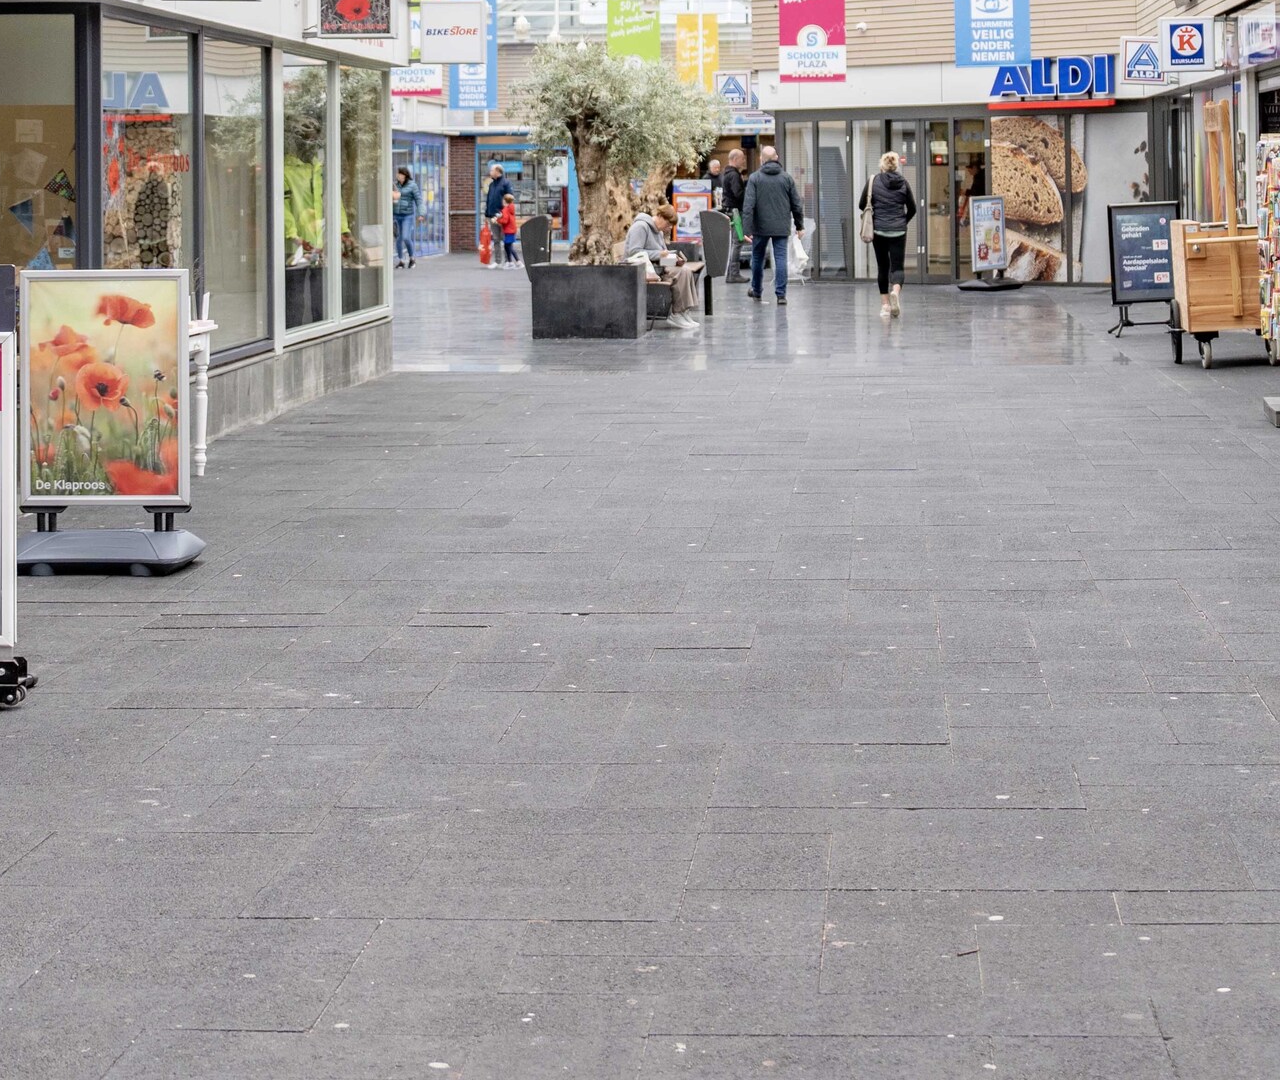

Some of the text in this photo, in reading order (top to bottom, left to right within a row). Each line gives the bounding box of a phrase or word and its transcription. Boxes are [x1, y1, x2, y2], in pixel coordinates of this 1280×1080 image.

[426, 26, 478, 36] BIKESTORE
[972, 29, 1014, 40] VEILIG
[971, 41, 1014, 50] ONDER-
[1177, 34, 1197, 51] K
[787, 51, 838, 60] SCHOOTEN
[972, 51, 1015, 62] NEMEN
[797, 60, 827, 68] PLAZA
[989, 54, 1115, 97] ALDI
[1131, 71, 1159, 79] ALDI
[1121, 232, 1142, 240] gehakt
[36, 479, 105, 492] De Klaproos
